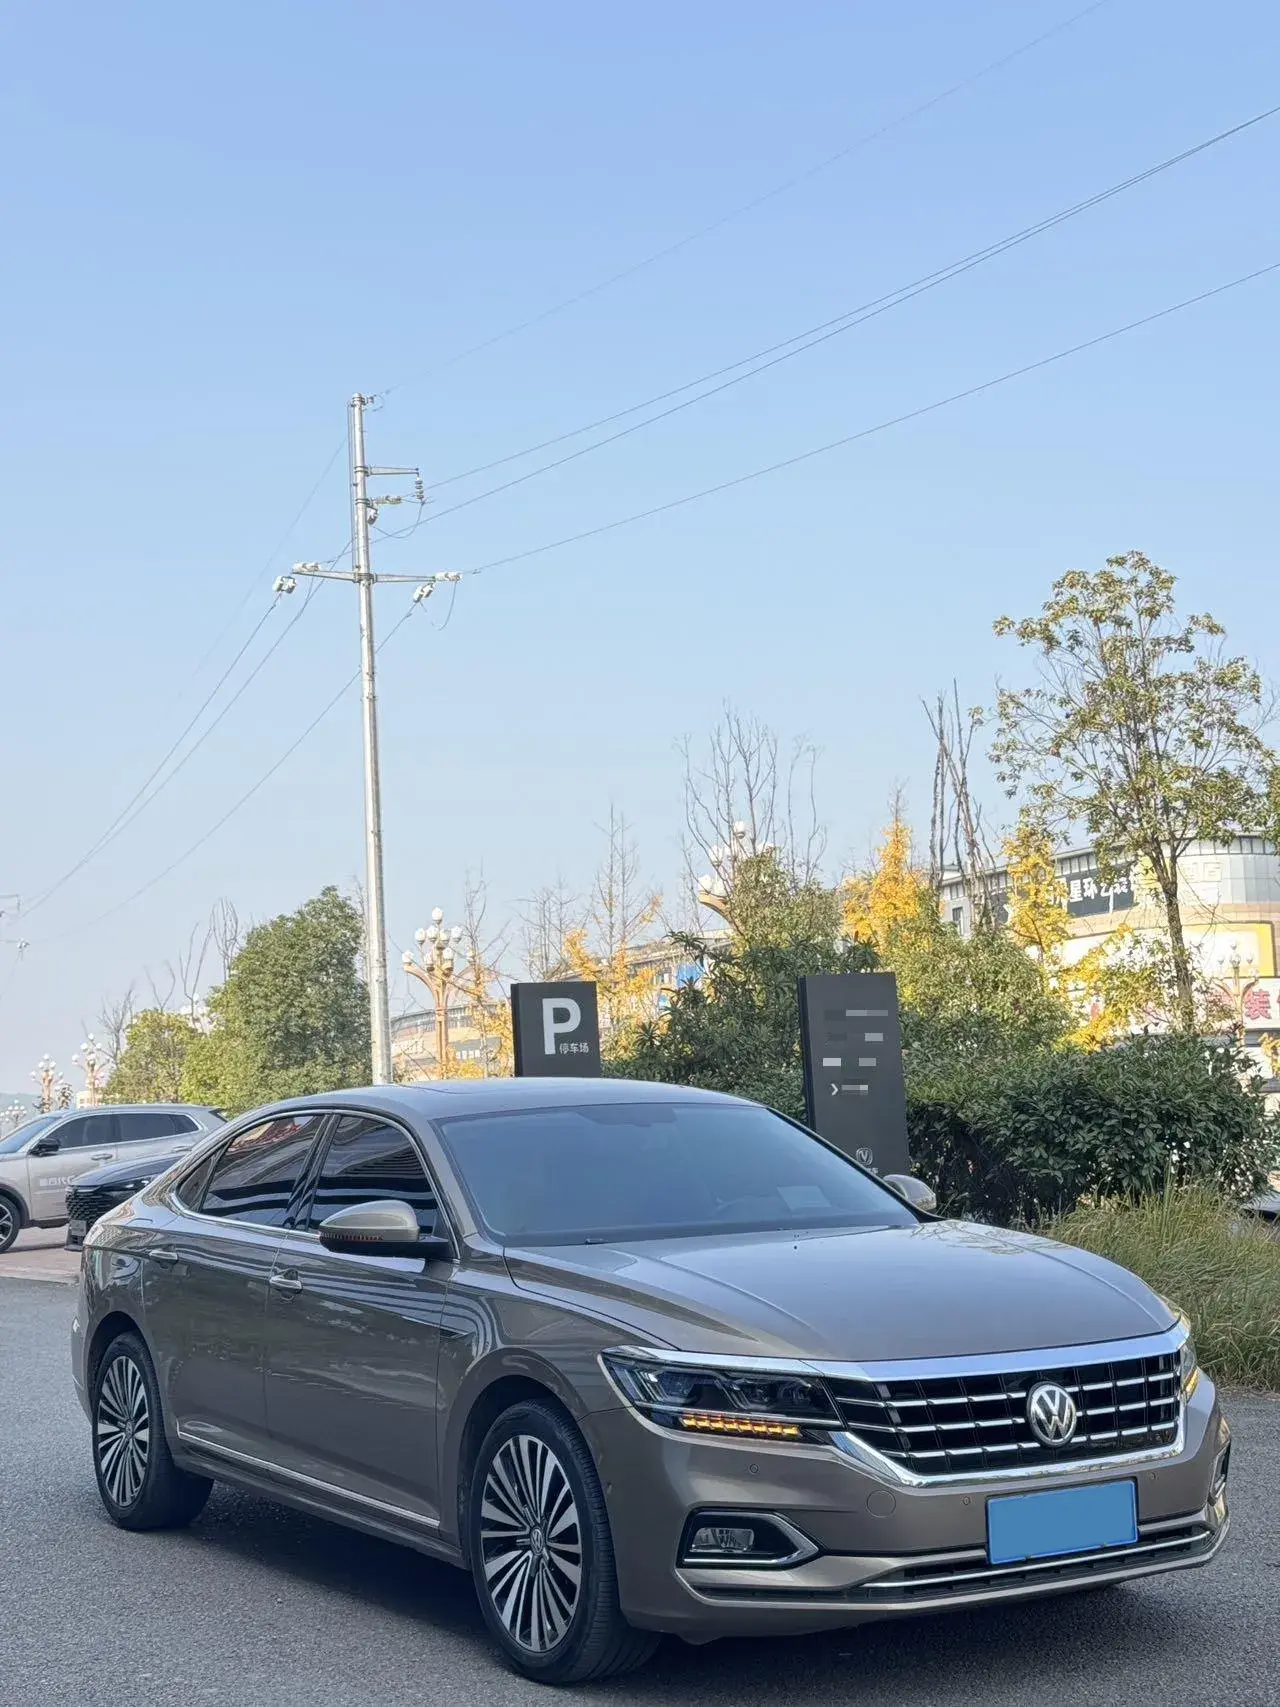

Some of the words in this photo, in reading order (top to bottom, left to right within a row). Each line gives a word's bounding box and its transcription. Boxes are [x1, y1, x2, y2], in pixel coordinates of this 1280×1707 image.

[542, 997, 581, 1055] P
[559, 1042, 590, 1055] 停车场
